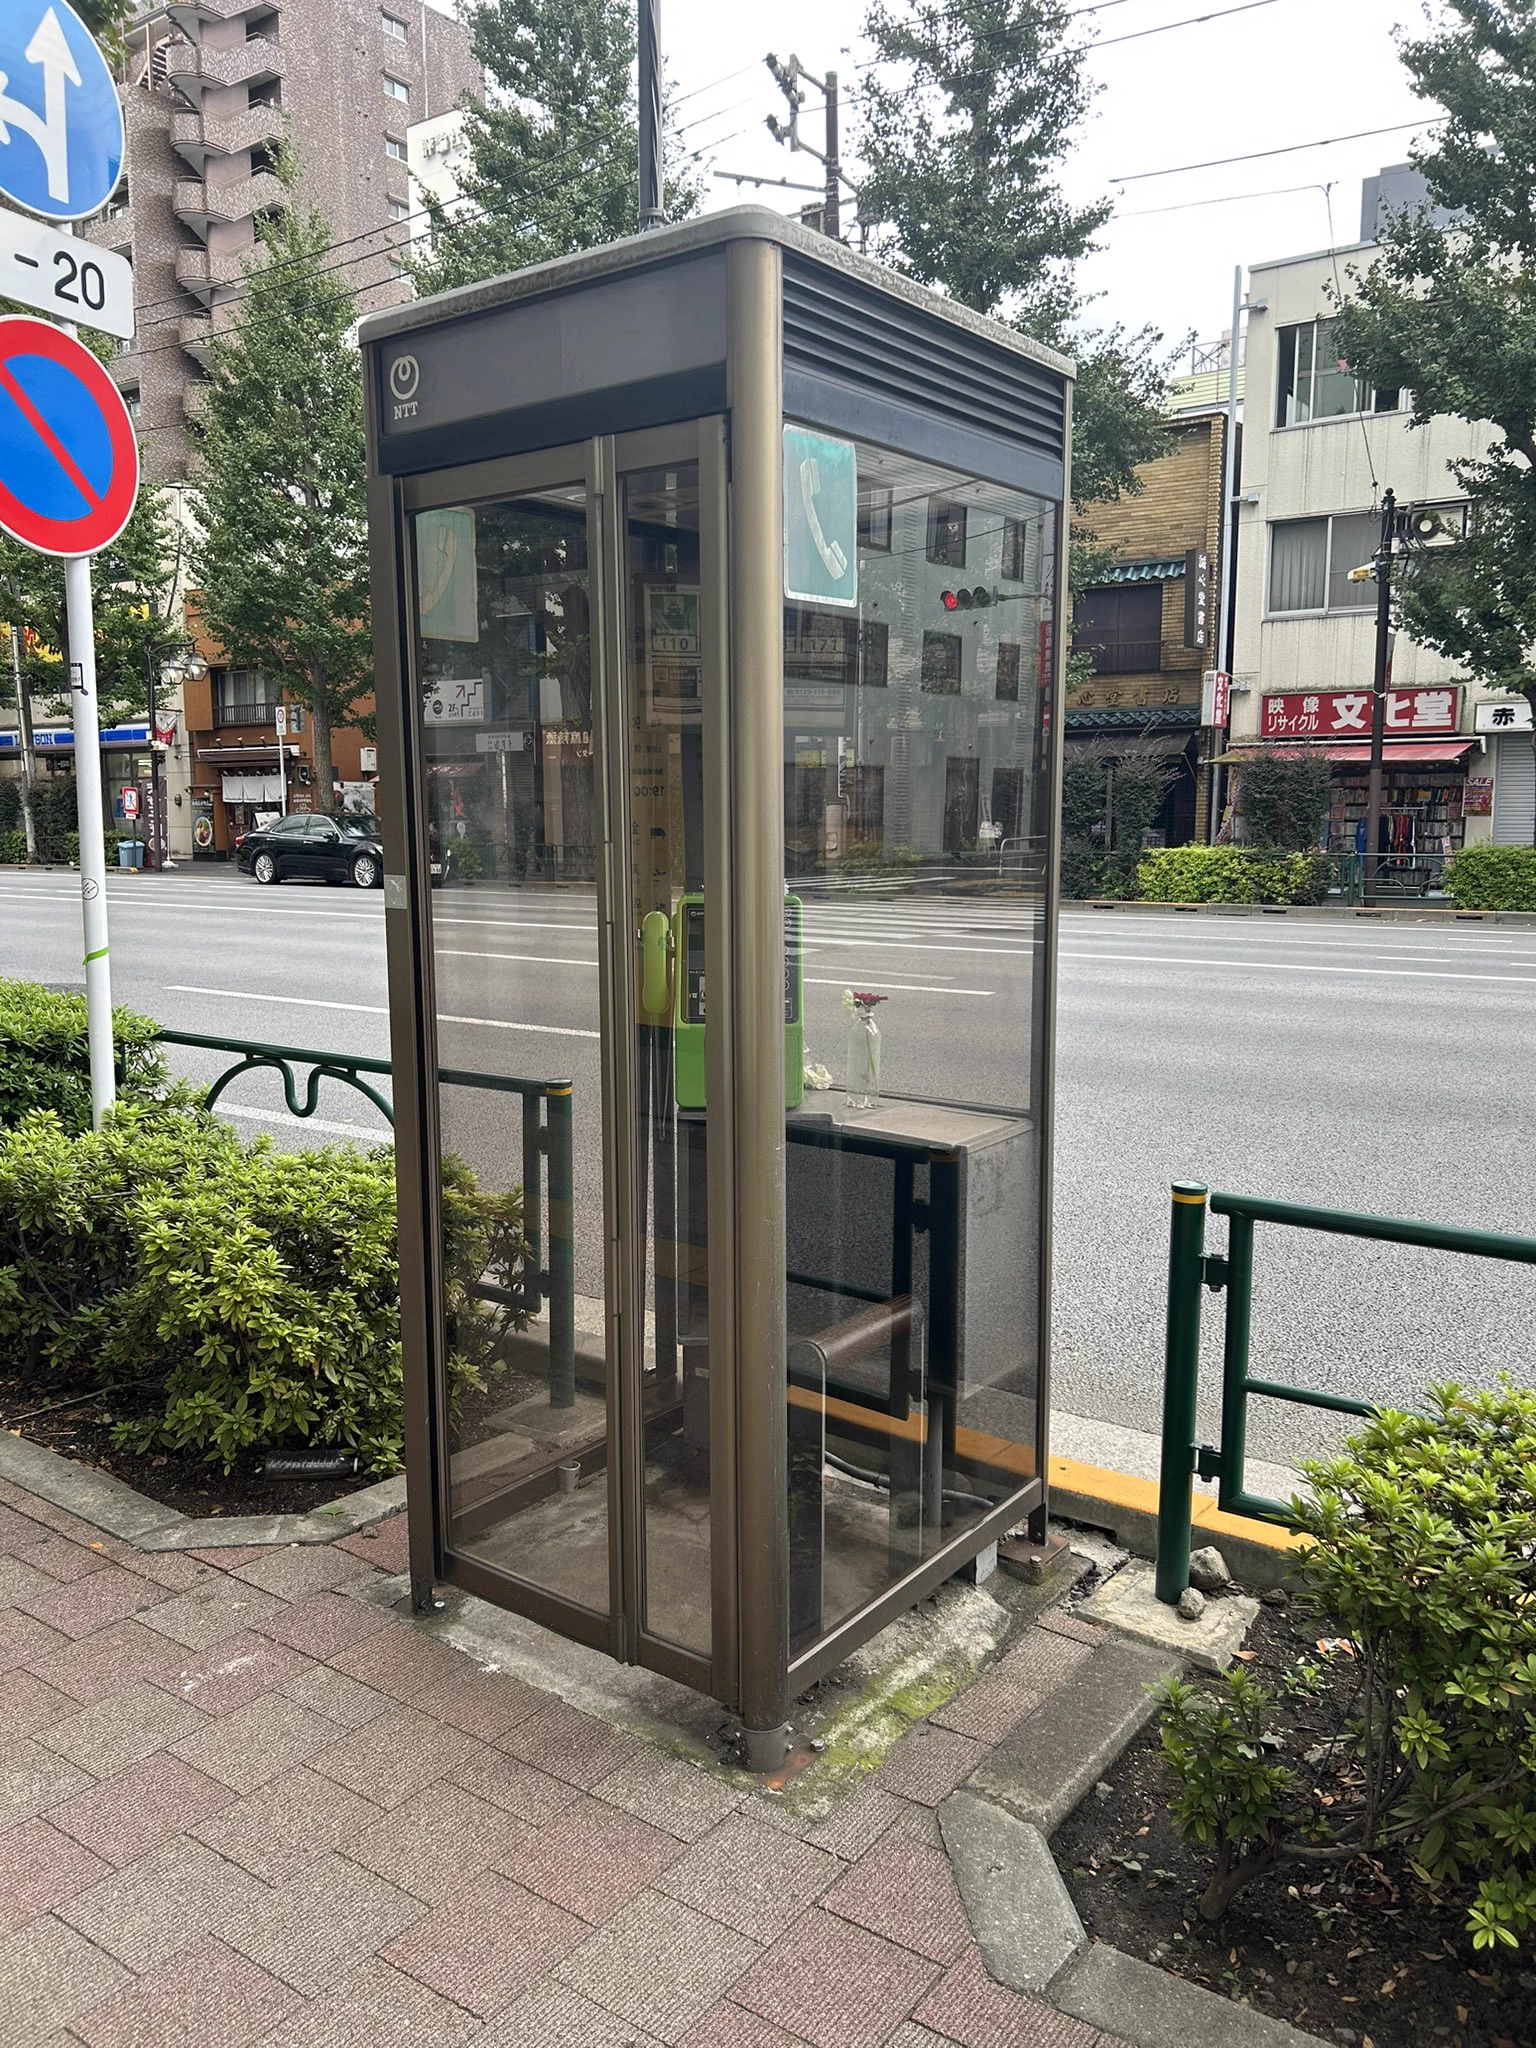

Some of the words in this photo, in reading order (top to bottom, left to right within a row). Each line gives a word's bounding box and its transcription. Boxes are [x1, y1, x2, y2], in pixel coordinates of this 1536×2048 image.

[393, 400, 419, 420] NTT
[660, 637, 689, 650] 110
[811, 638, 837, 651] 171
[1267, 714, 1319, 732] リサイクル
[1492, 707, 1516, 726] 赤
[14, 733, 53, 746] LSON
[1465, 778, 1492, 787] SALE
